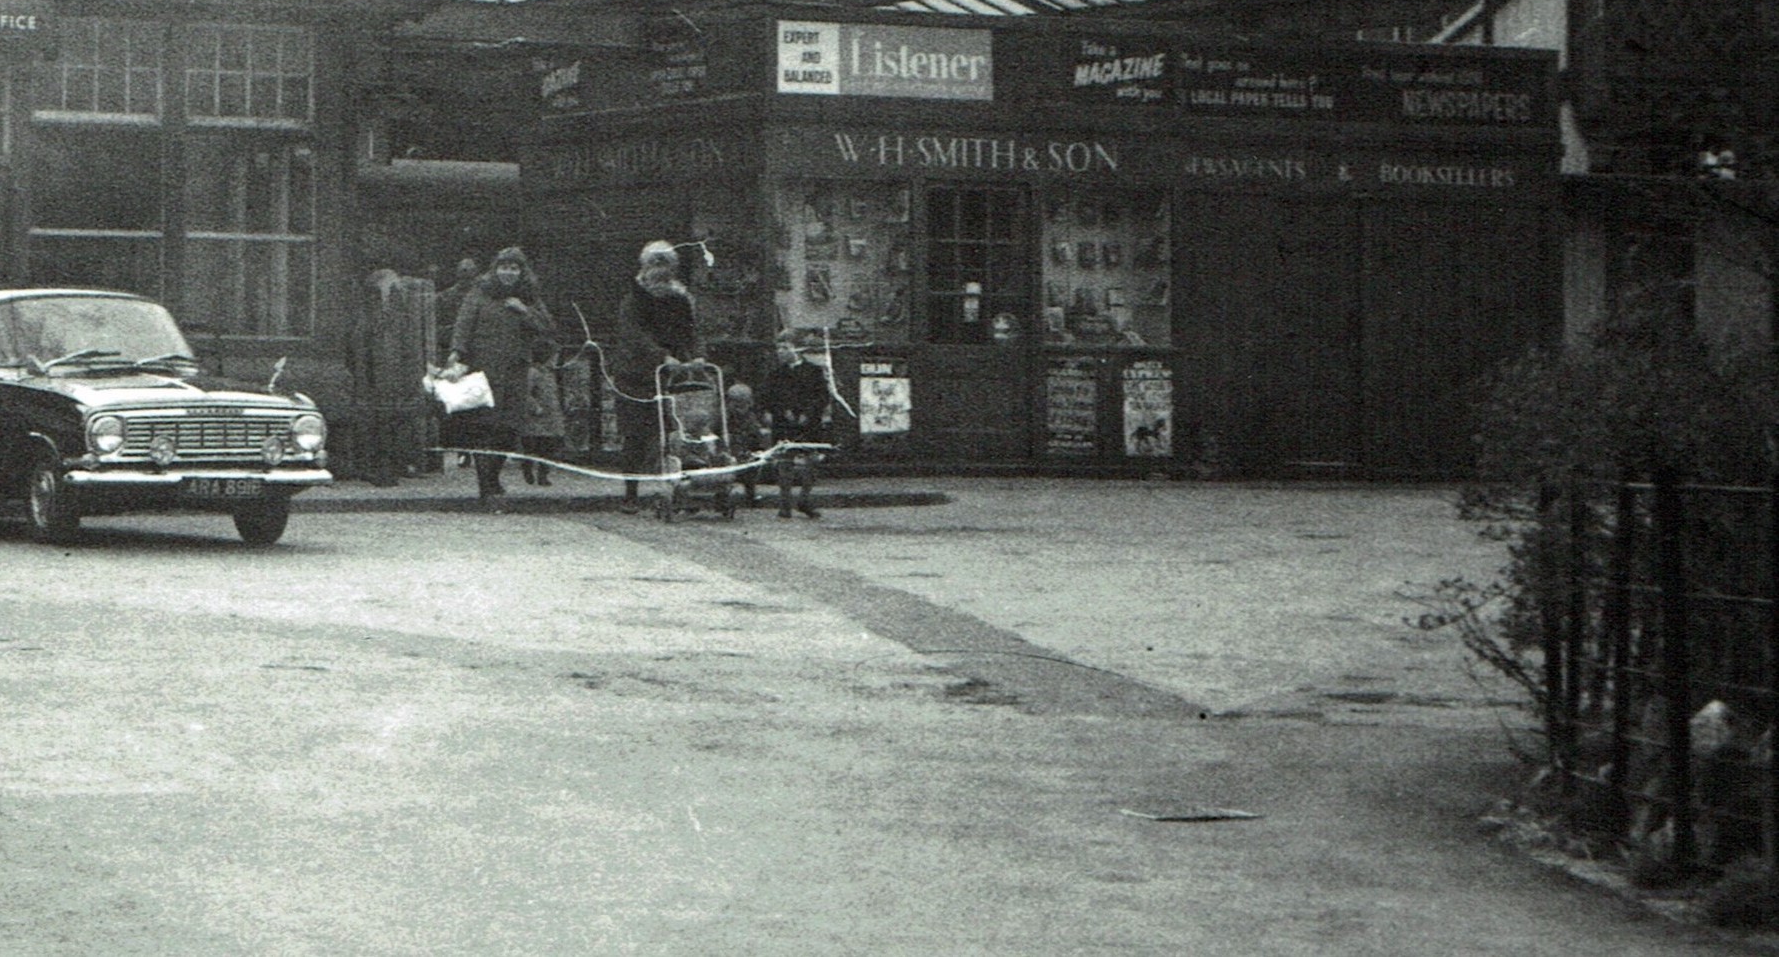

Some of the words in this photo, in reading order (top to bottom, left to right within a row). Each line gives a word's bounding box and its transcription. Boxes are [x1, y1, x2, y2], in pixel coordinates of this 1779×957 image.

[783, 30, 820, 45] EXPERT
[802, 50, 822, 64] AND
[851, 37, 986, 82] Listener
[783, 69, 833, 85] BALANCED
[1074, 53, 1166, 87] MAGAZINE
[1190, 89, 1226, 105] LOCAL
[1231, 91, 1269, 107] PAPER
[1272, 93, 1306, 108] TELLS
[1402, 89, 1530, 121] NEWSPAPERS
[1048, 141, 1118, 173] SON
[1379, 159, 1515, 187] BOOKSELLERS
[186, 479, 220, 495] ARA
